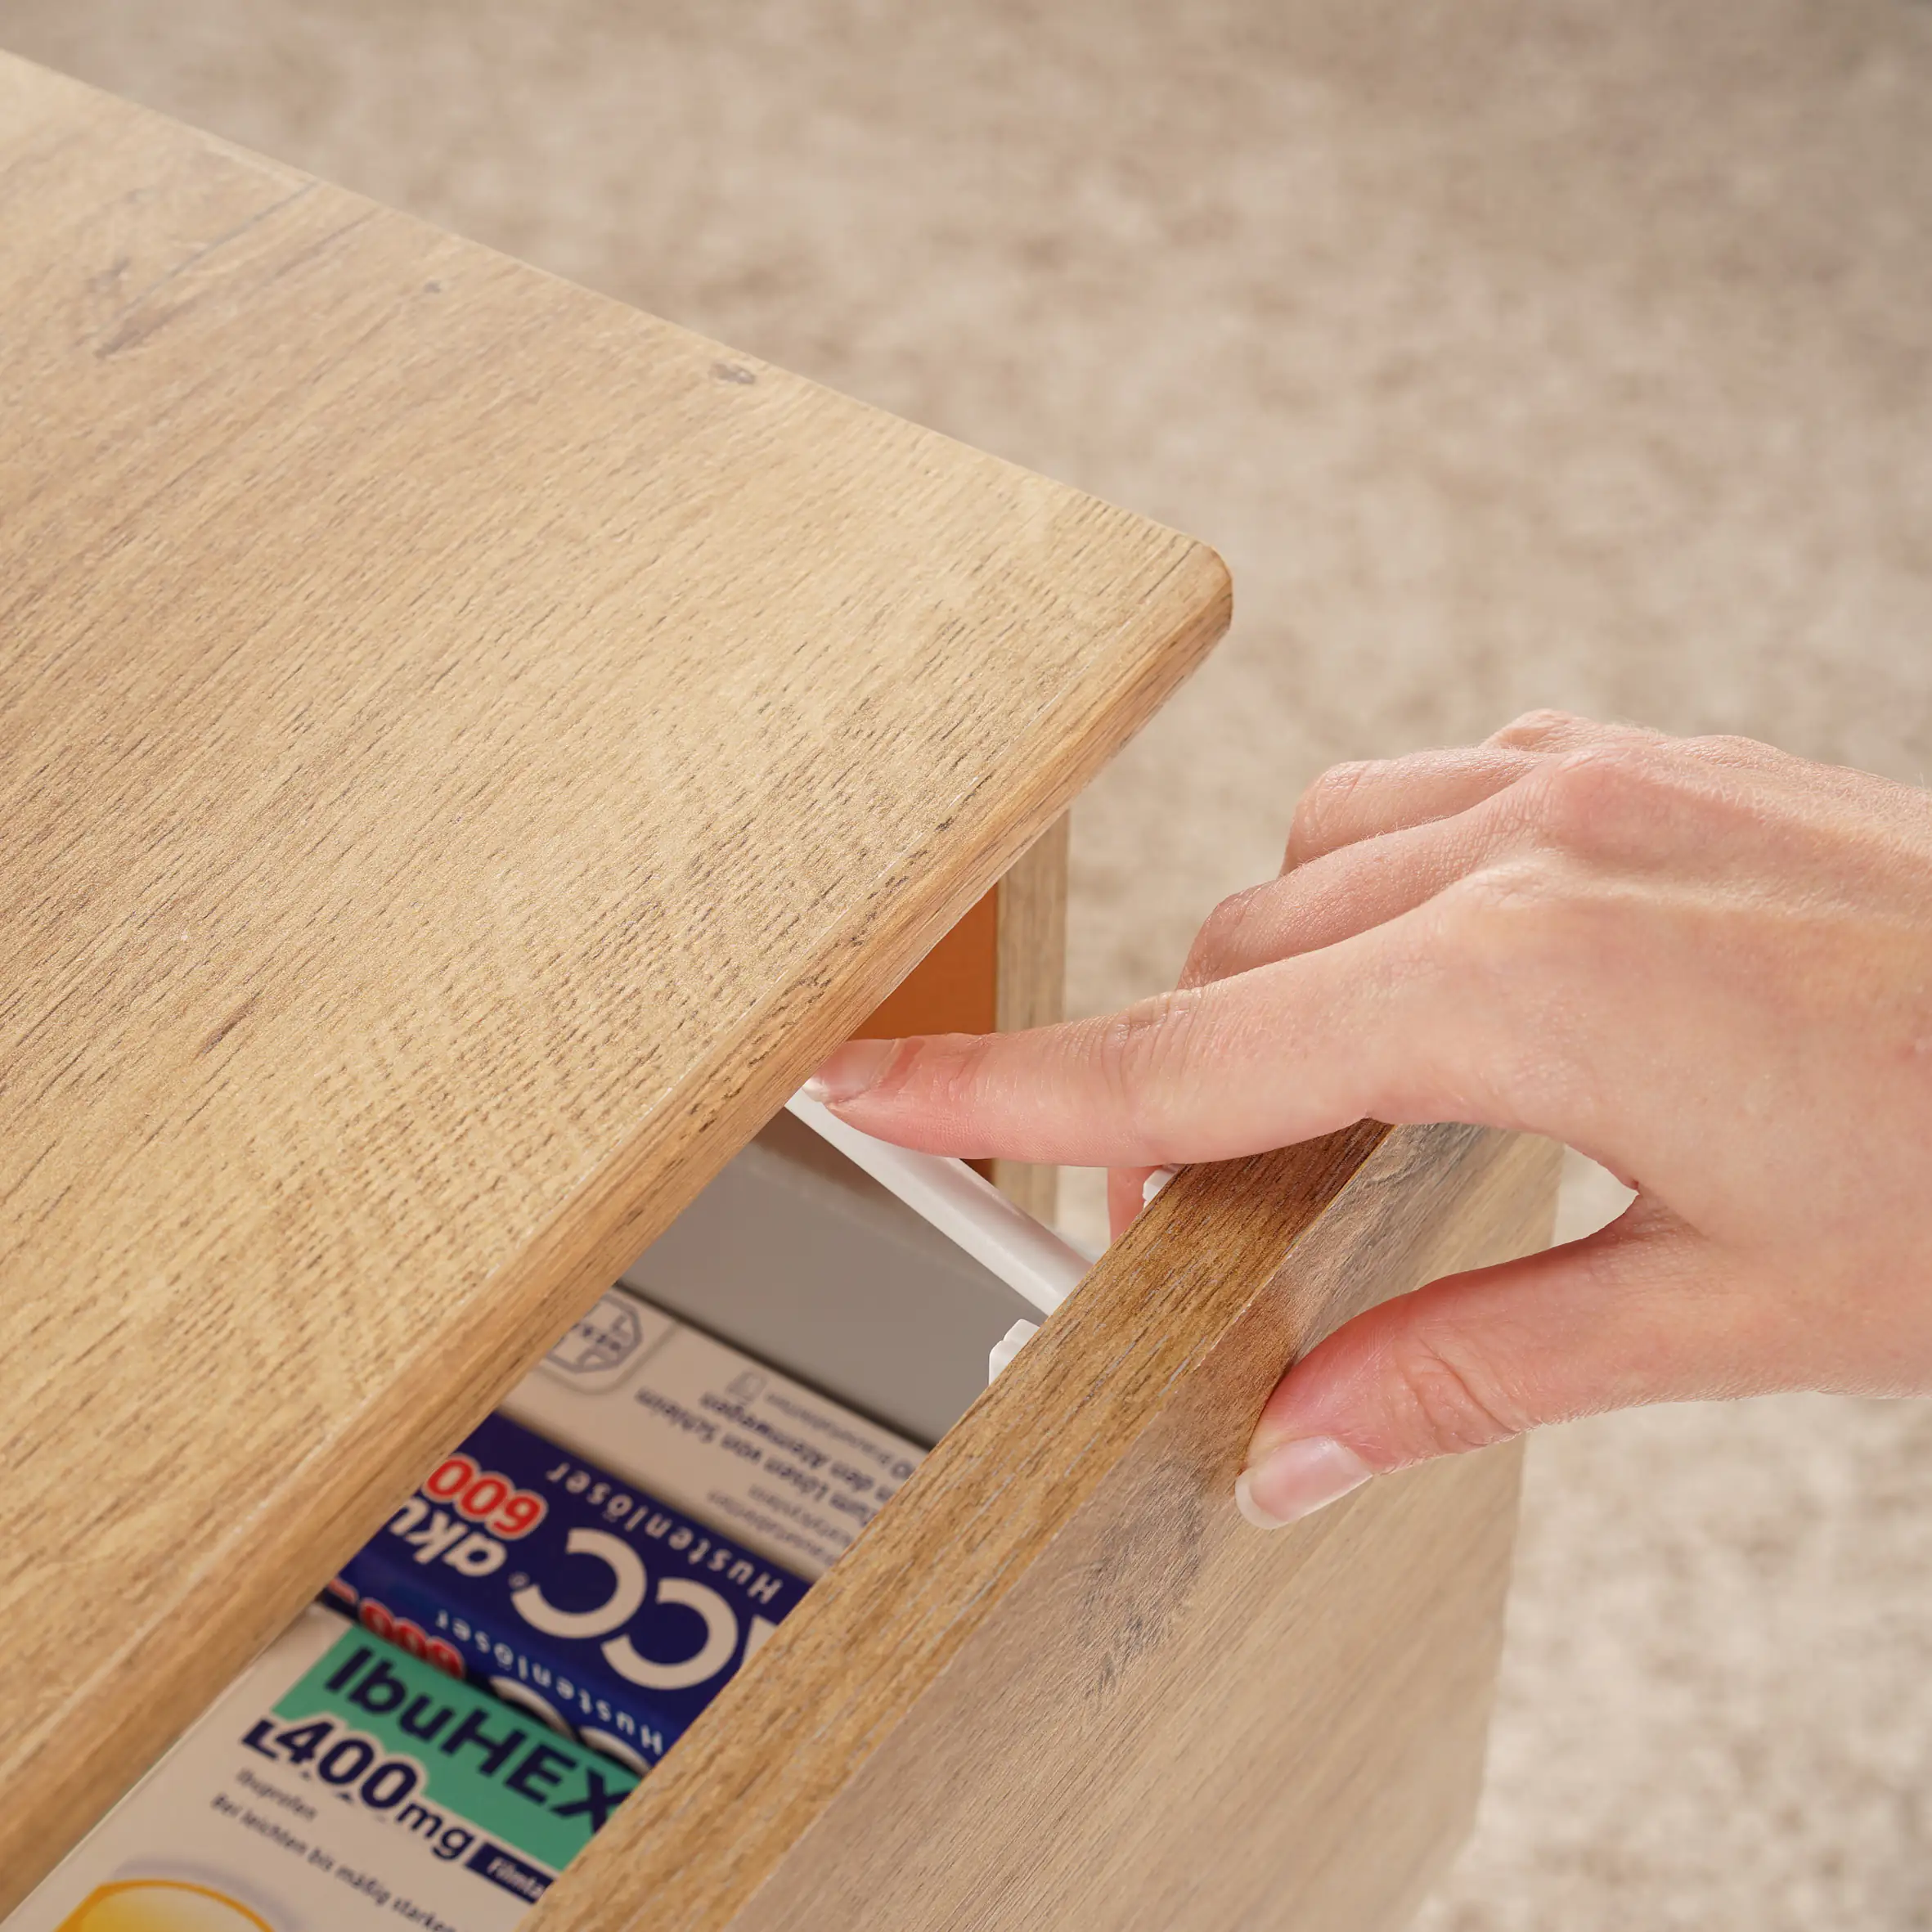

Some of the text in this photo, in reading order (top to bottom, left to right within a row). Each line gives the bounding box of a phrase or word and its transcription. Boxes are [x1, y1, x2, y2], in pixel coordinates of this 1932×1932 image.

[424, 1453, 547, 1538] 600
[546, 1461, 784, 1604] Hustenlöser
[325, 1646, 631, 1836] IbuHEX
[435, 1609, 664, 1756] Hustenlöser
